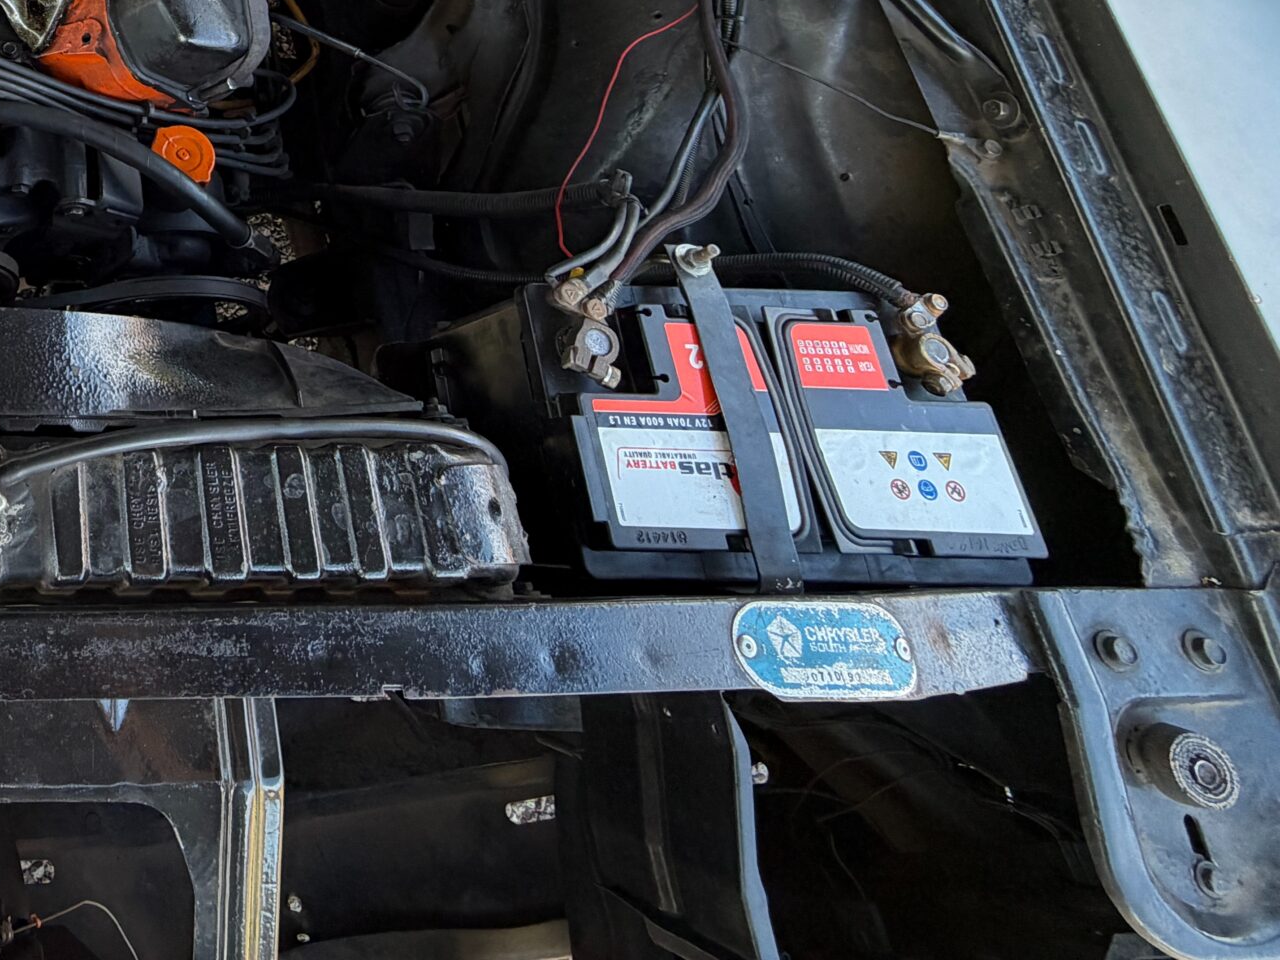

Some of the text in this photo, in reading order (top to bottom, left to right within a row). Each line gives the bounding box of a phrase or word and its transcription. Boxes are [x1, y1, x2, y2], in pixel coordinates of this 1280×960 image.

[608, 415, 713, 428] 12V 70Ah 600A EN L3
[624, 450, 697, 460] UNBEATABLE QUALITY
[626, 459, 735, 480] tlas BATTERY
[206, 462, 224, 529] CHRYSLER
[804, 626, 881, 643] CHRYSLER
[809, 642, 846, 653] SOUTH
